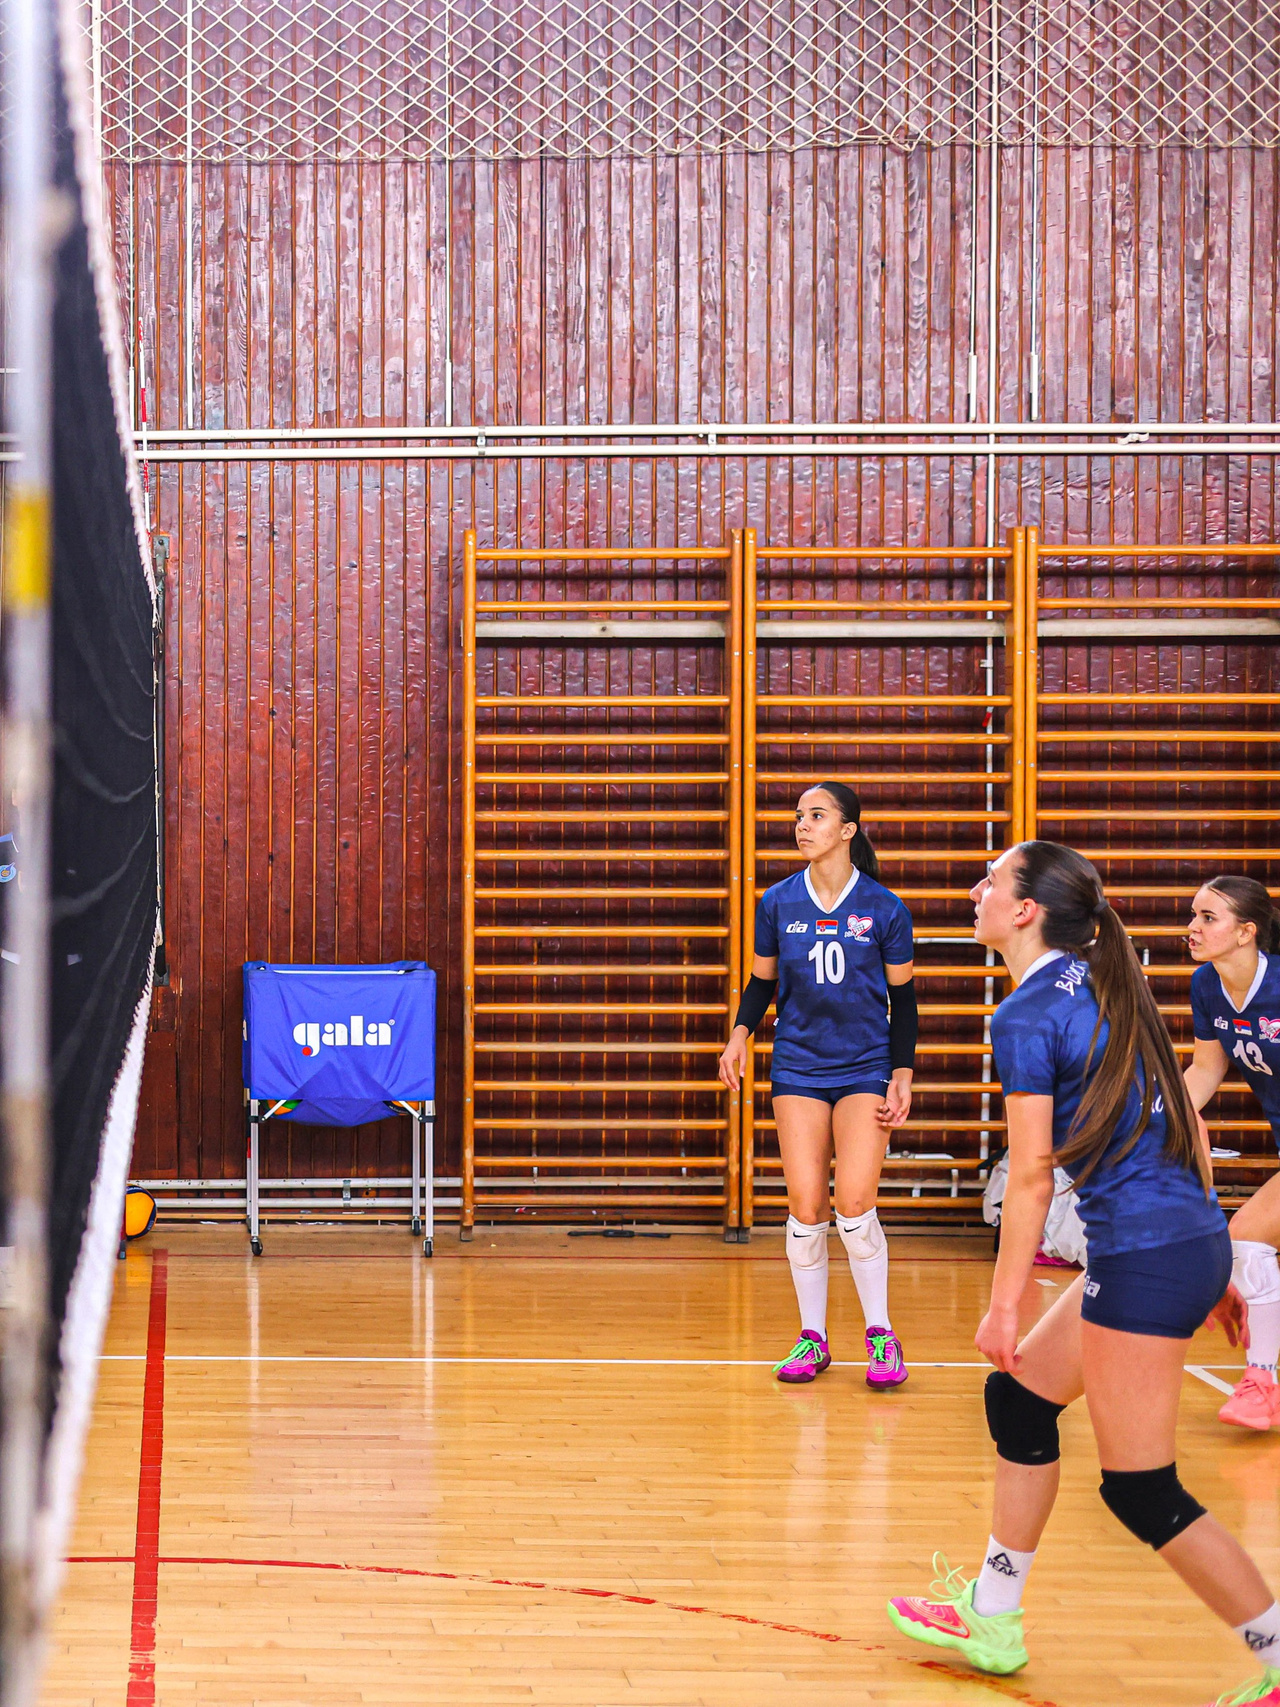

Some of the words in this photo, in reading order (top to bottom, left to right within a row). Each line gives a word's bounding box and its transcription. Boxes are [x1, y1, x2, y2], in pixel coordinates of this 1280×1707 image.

[807, 940, 846, 985] 10
[292, 1015, 392, 1057] gala
[987, 1556, 1020, 1578] PEAK
